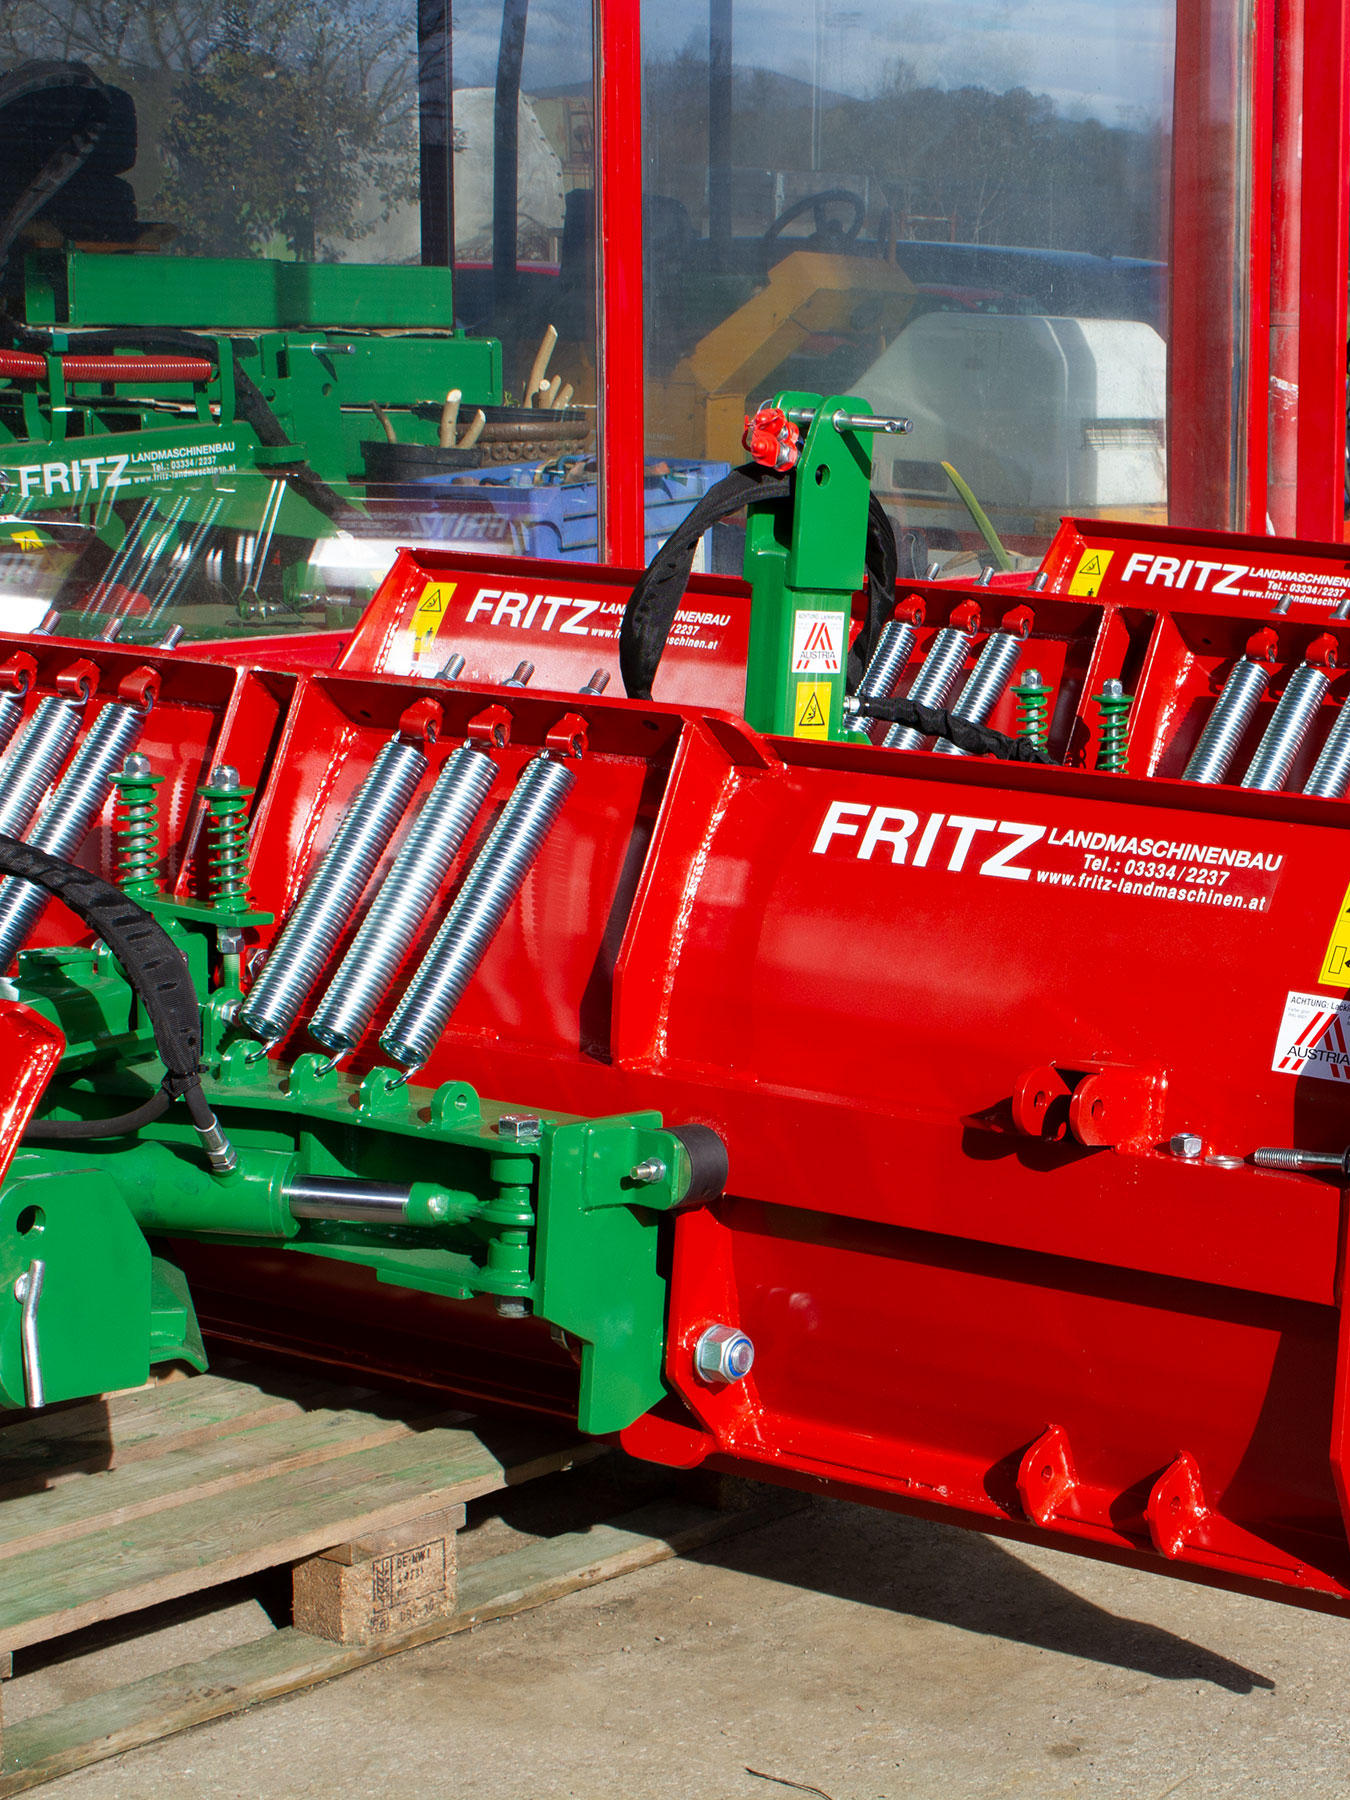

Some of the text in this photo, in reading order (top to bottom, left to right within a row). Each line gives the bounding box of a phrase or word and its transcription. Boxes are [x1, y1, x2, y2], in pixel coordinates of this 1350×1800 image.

[131, 442, 236, 464] LANDMASCHINENBAU
[19, 454, 133, 498] FRITZ
[1120, 552, 1250, 596] FRITZ
[1267, 580, 1288, 592] Tel.:
[465, 588, 600, 636] FRITZ
[600, 601, 731, 626] LANINENBAU
[800, 651, 836, 660] AUSTRIA
[811, 800, 1047, 881] FRITZ
[1047, 827, 1283, 872] LANDMASCHINENBAU
[1083, 854, 1230, 887] Tel.: 03334/2237
[1036, 870, 1267, 911] www.fritz-landmaschinen.at
[1290, 996, 1330, 1010] ACHTUNG:
[1287, 1046, 1350, 1066] AUSTRIA
